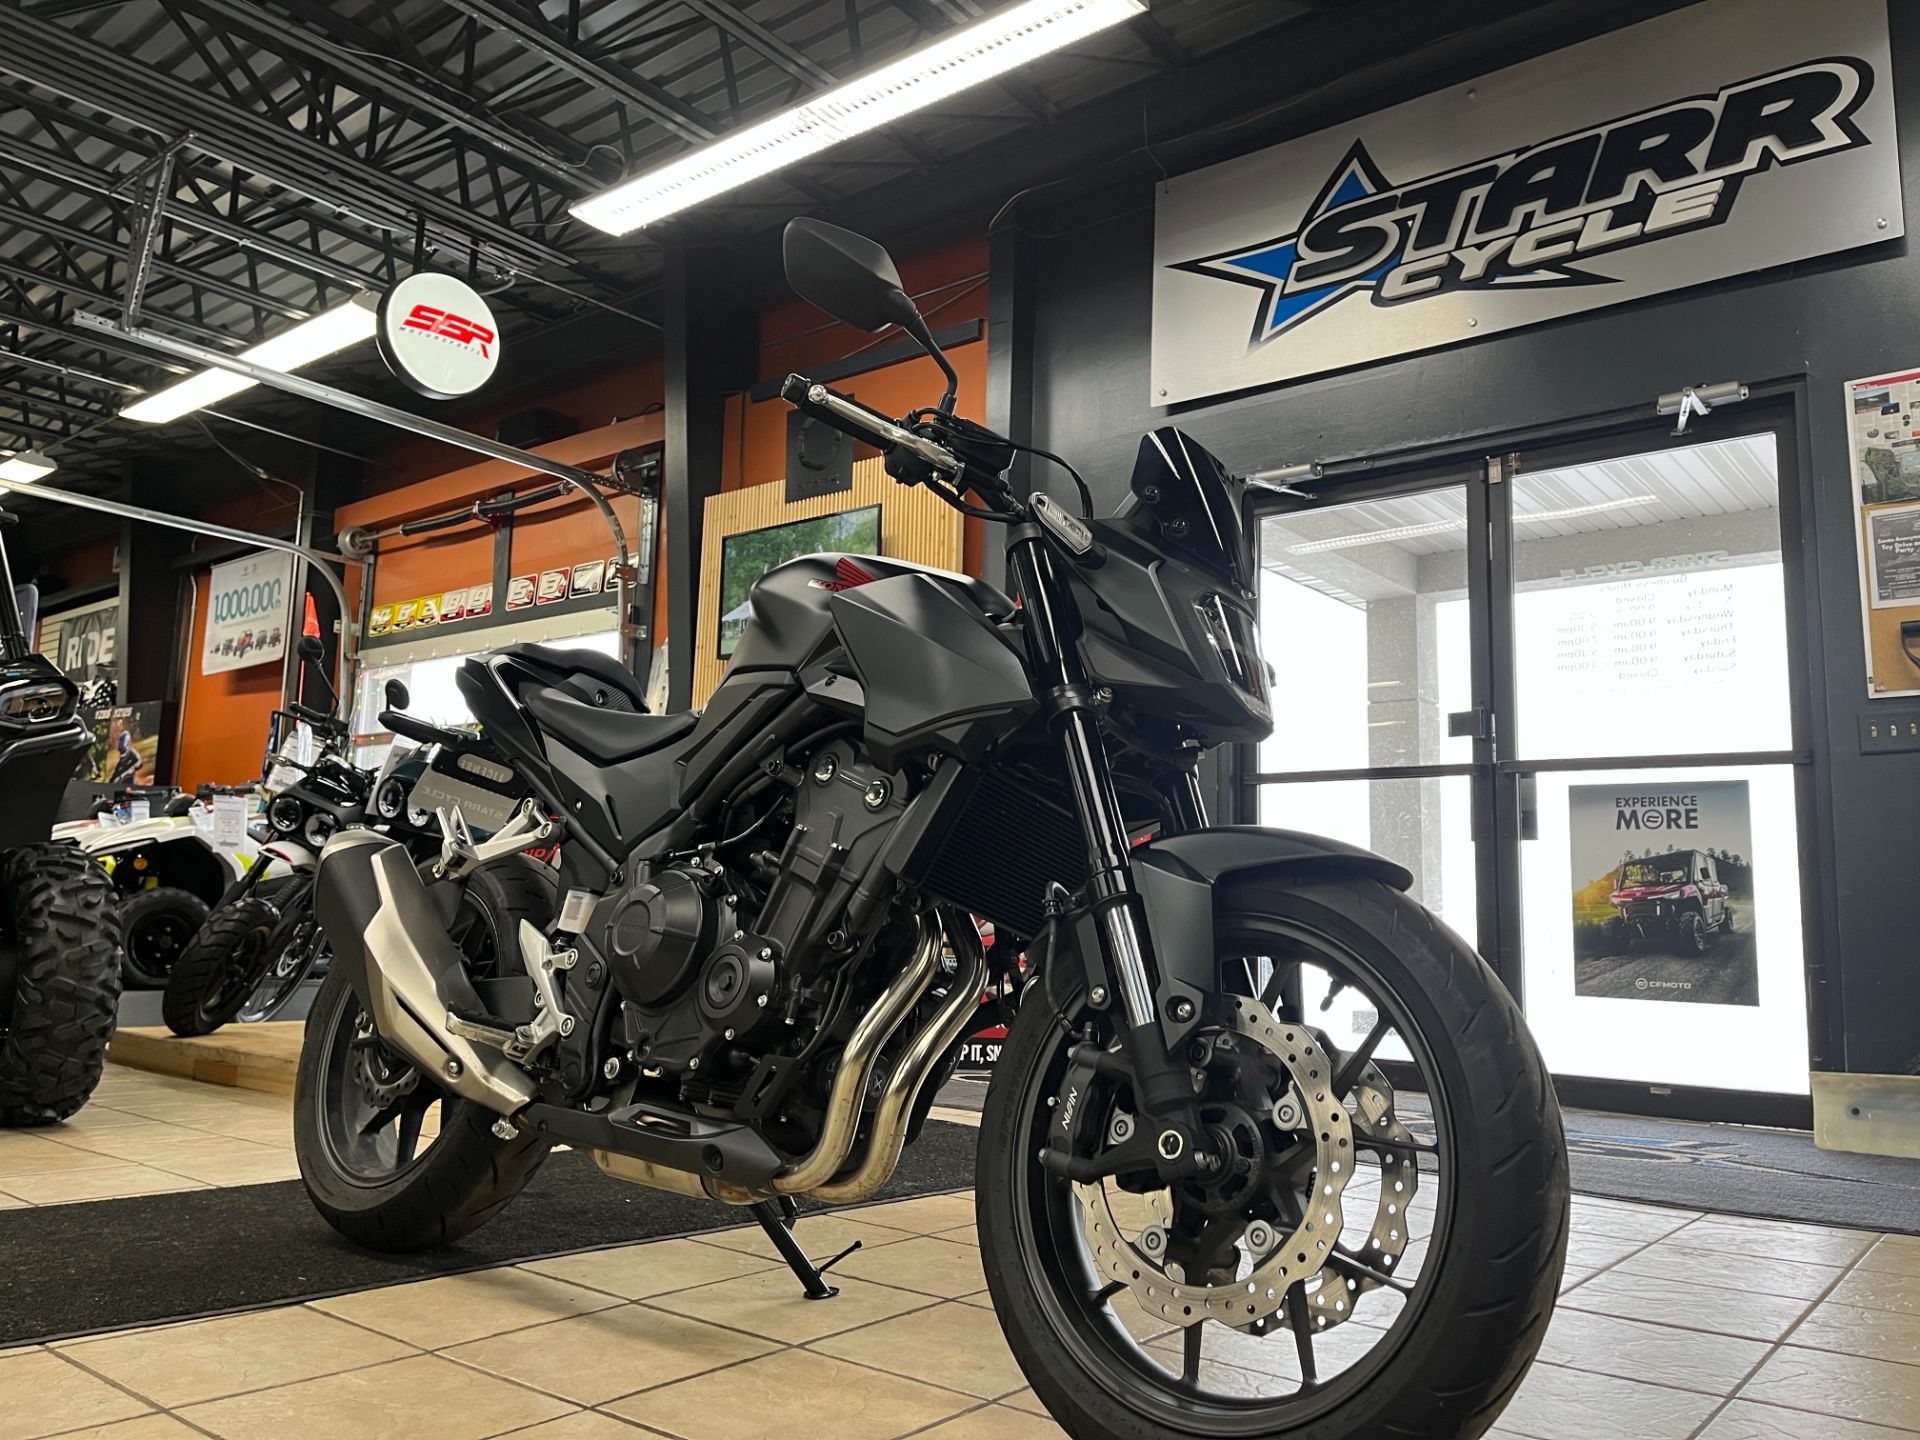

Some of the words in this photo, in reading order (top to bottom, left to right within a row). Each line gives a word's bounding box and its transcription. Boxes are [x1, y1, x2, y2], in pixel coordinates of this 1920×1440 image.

[1287, 62, 1856, 290] STARR
[1379, 179, 1726, 301] CYCLE
[402, 304, 495, 360] SSR
[65, 627, 115, 671] RIDE
[1615, 795, 1698, 808] EXPERIENCE
[1615, 808, 1699, 831] MORE
[1649, 980, 1691, 990] CFMOTO
[971, 1044, 983, 1064] IT,
